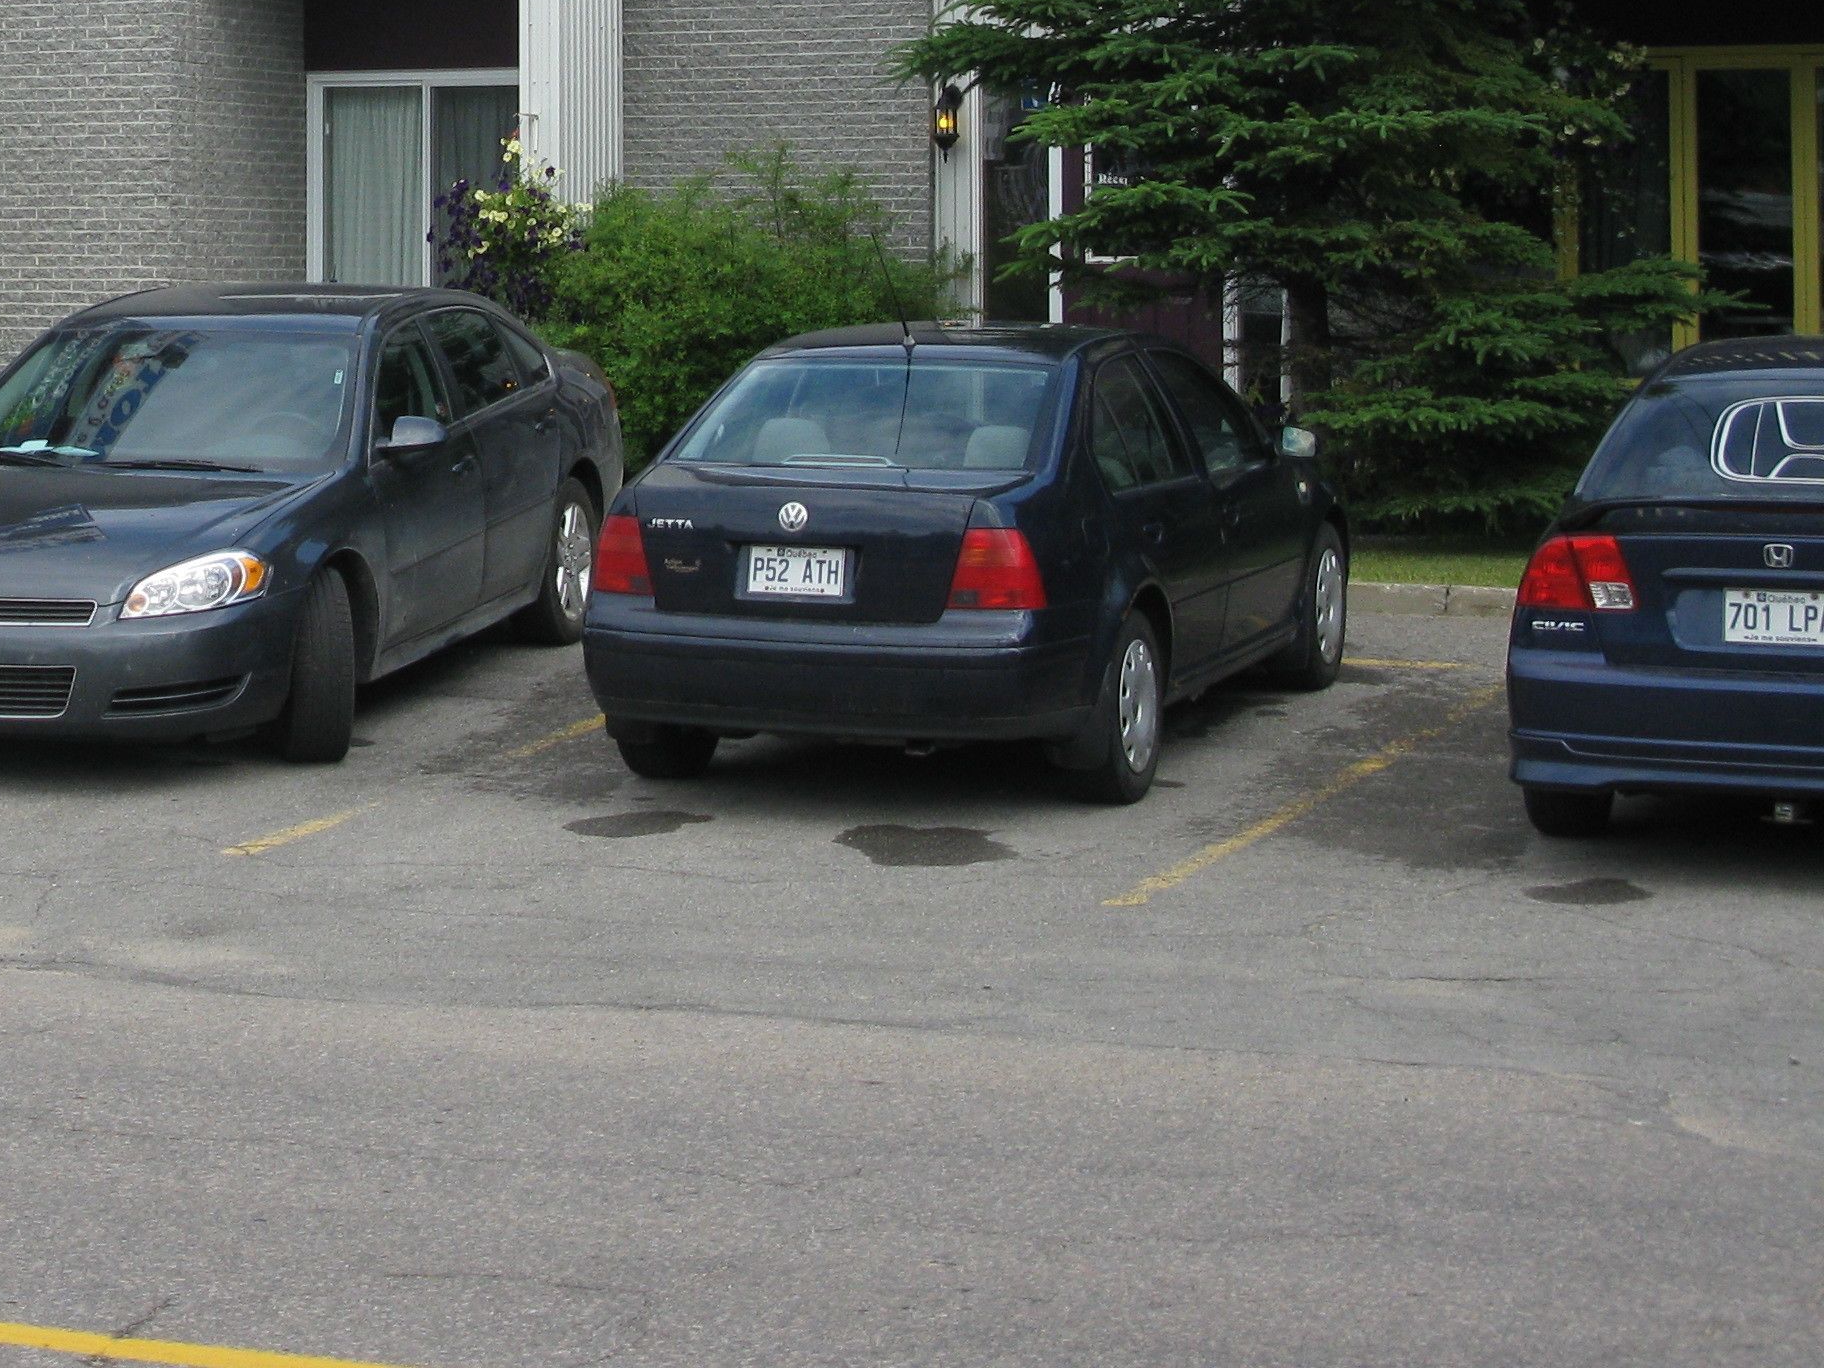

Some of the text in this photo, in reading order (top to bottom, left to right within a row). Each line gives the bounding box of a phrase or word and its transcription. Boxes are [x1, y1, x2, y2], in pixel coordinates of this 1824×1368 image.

[647, 518, 694, 530] JETTA
[752, 557, 840, 585] P52 ATH
[1531, 620, 1585, 632] CIVIC
[1728, 602, 1770, 631] 701
